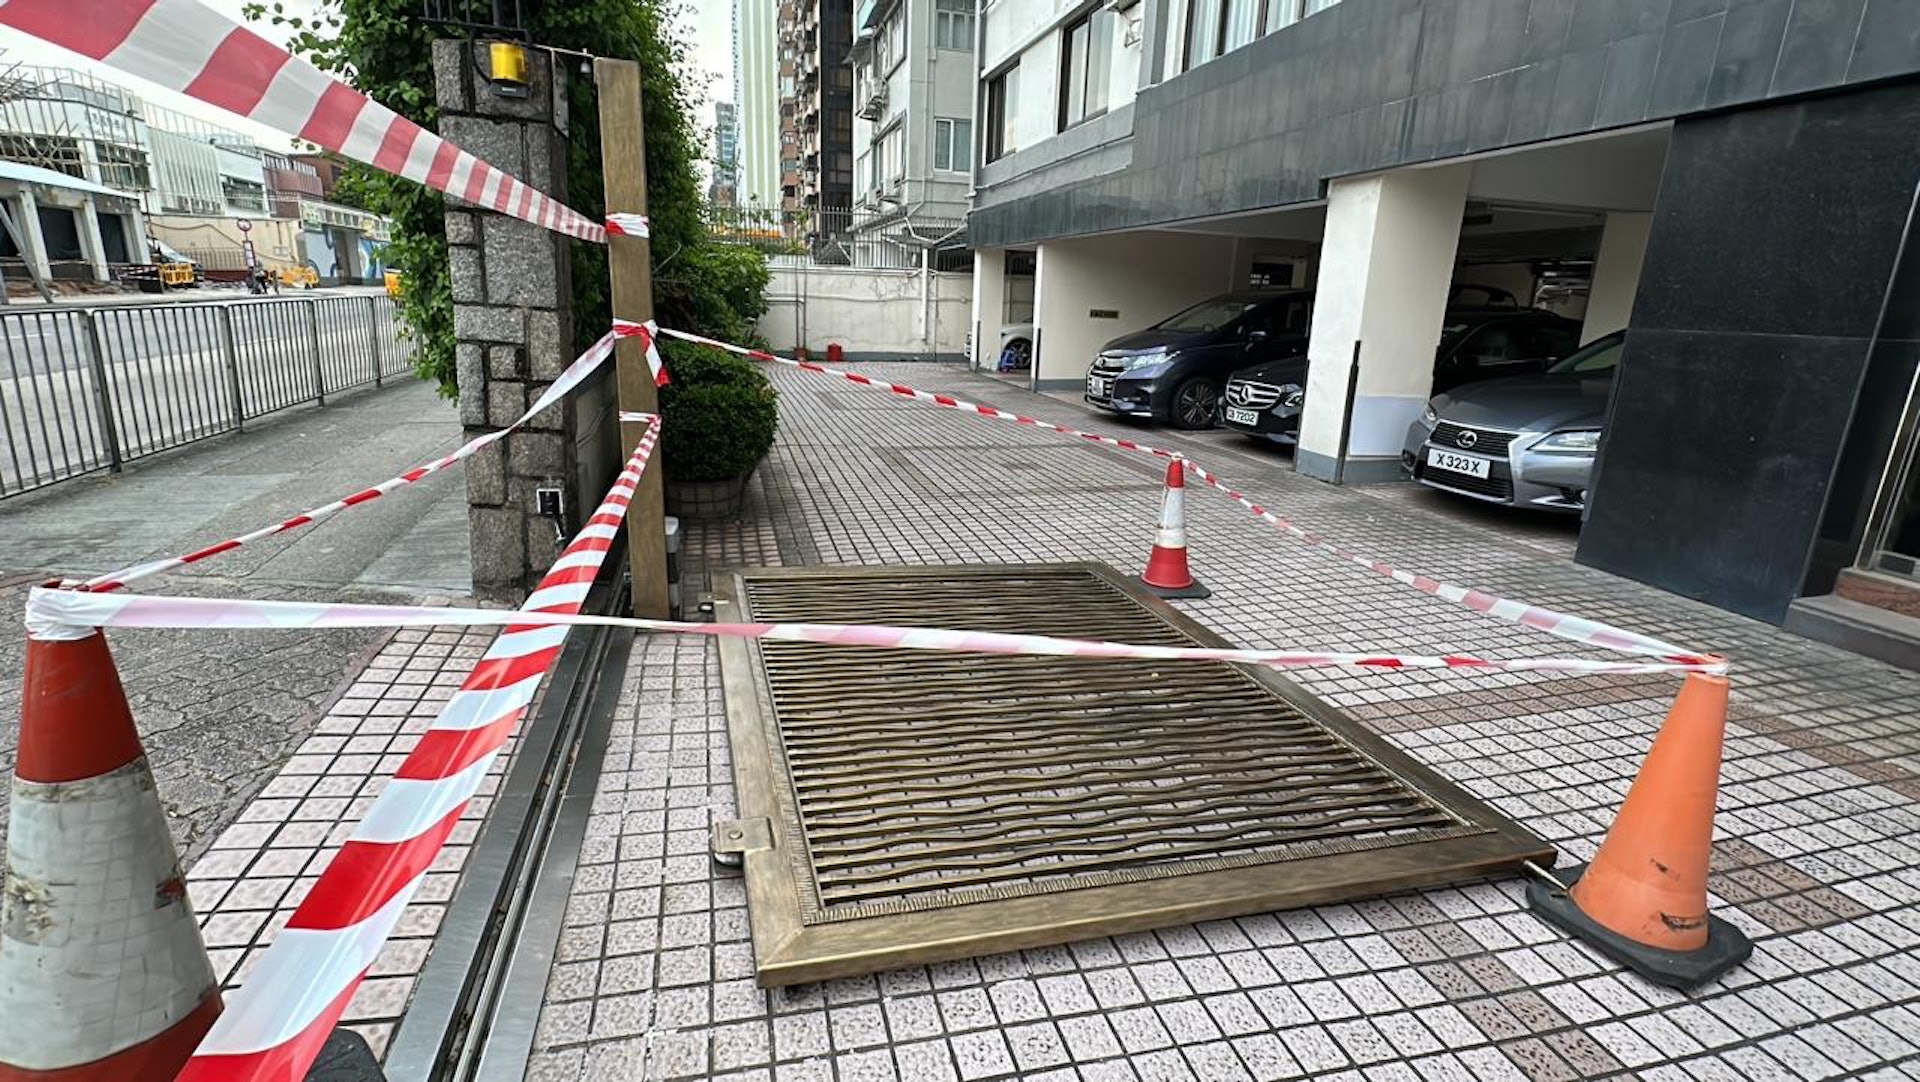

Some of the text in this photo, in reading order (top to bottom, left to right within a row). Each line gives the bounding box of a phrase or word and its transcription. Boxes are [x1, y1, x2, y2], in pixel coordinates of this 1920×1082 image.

[1236, 410, 1255, 423] 7202
[1436, 453, 1480, 474] X 323 X
